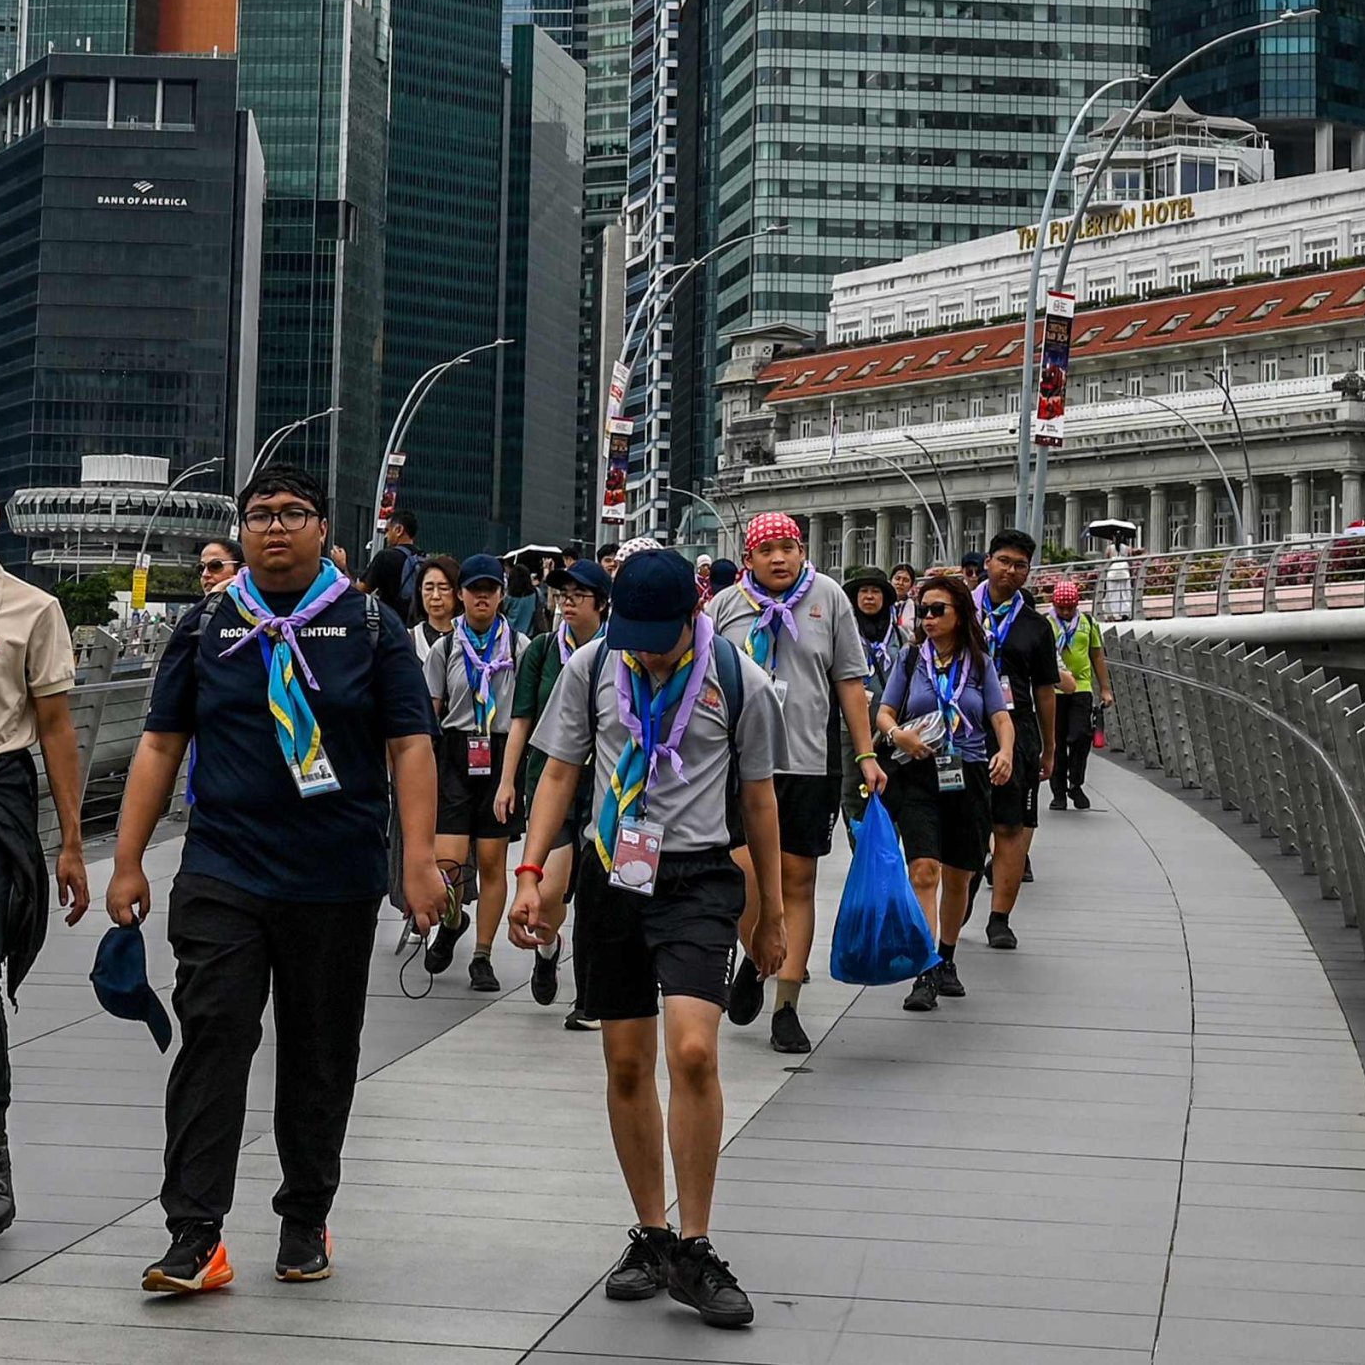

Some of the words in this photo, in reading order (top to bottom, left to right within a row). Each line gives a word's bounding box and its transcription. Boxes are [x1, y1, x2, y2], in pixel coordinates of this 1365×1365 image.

[97, 196, 125, 205] BANK
[127, 196, 141, 205] OF
[141, 197, 188, 206] AMERICA
[1017, 227, 1040, 251] TH
[1049, 207, 1136, 245] FULERTON
[1141, 196, 1195, 227] HOTEL
[300, 627, 347, 637] ENTURE
